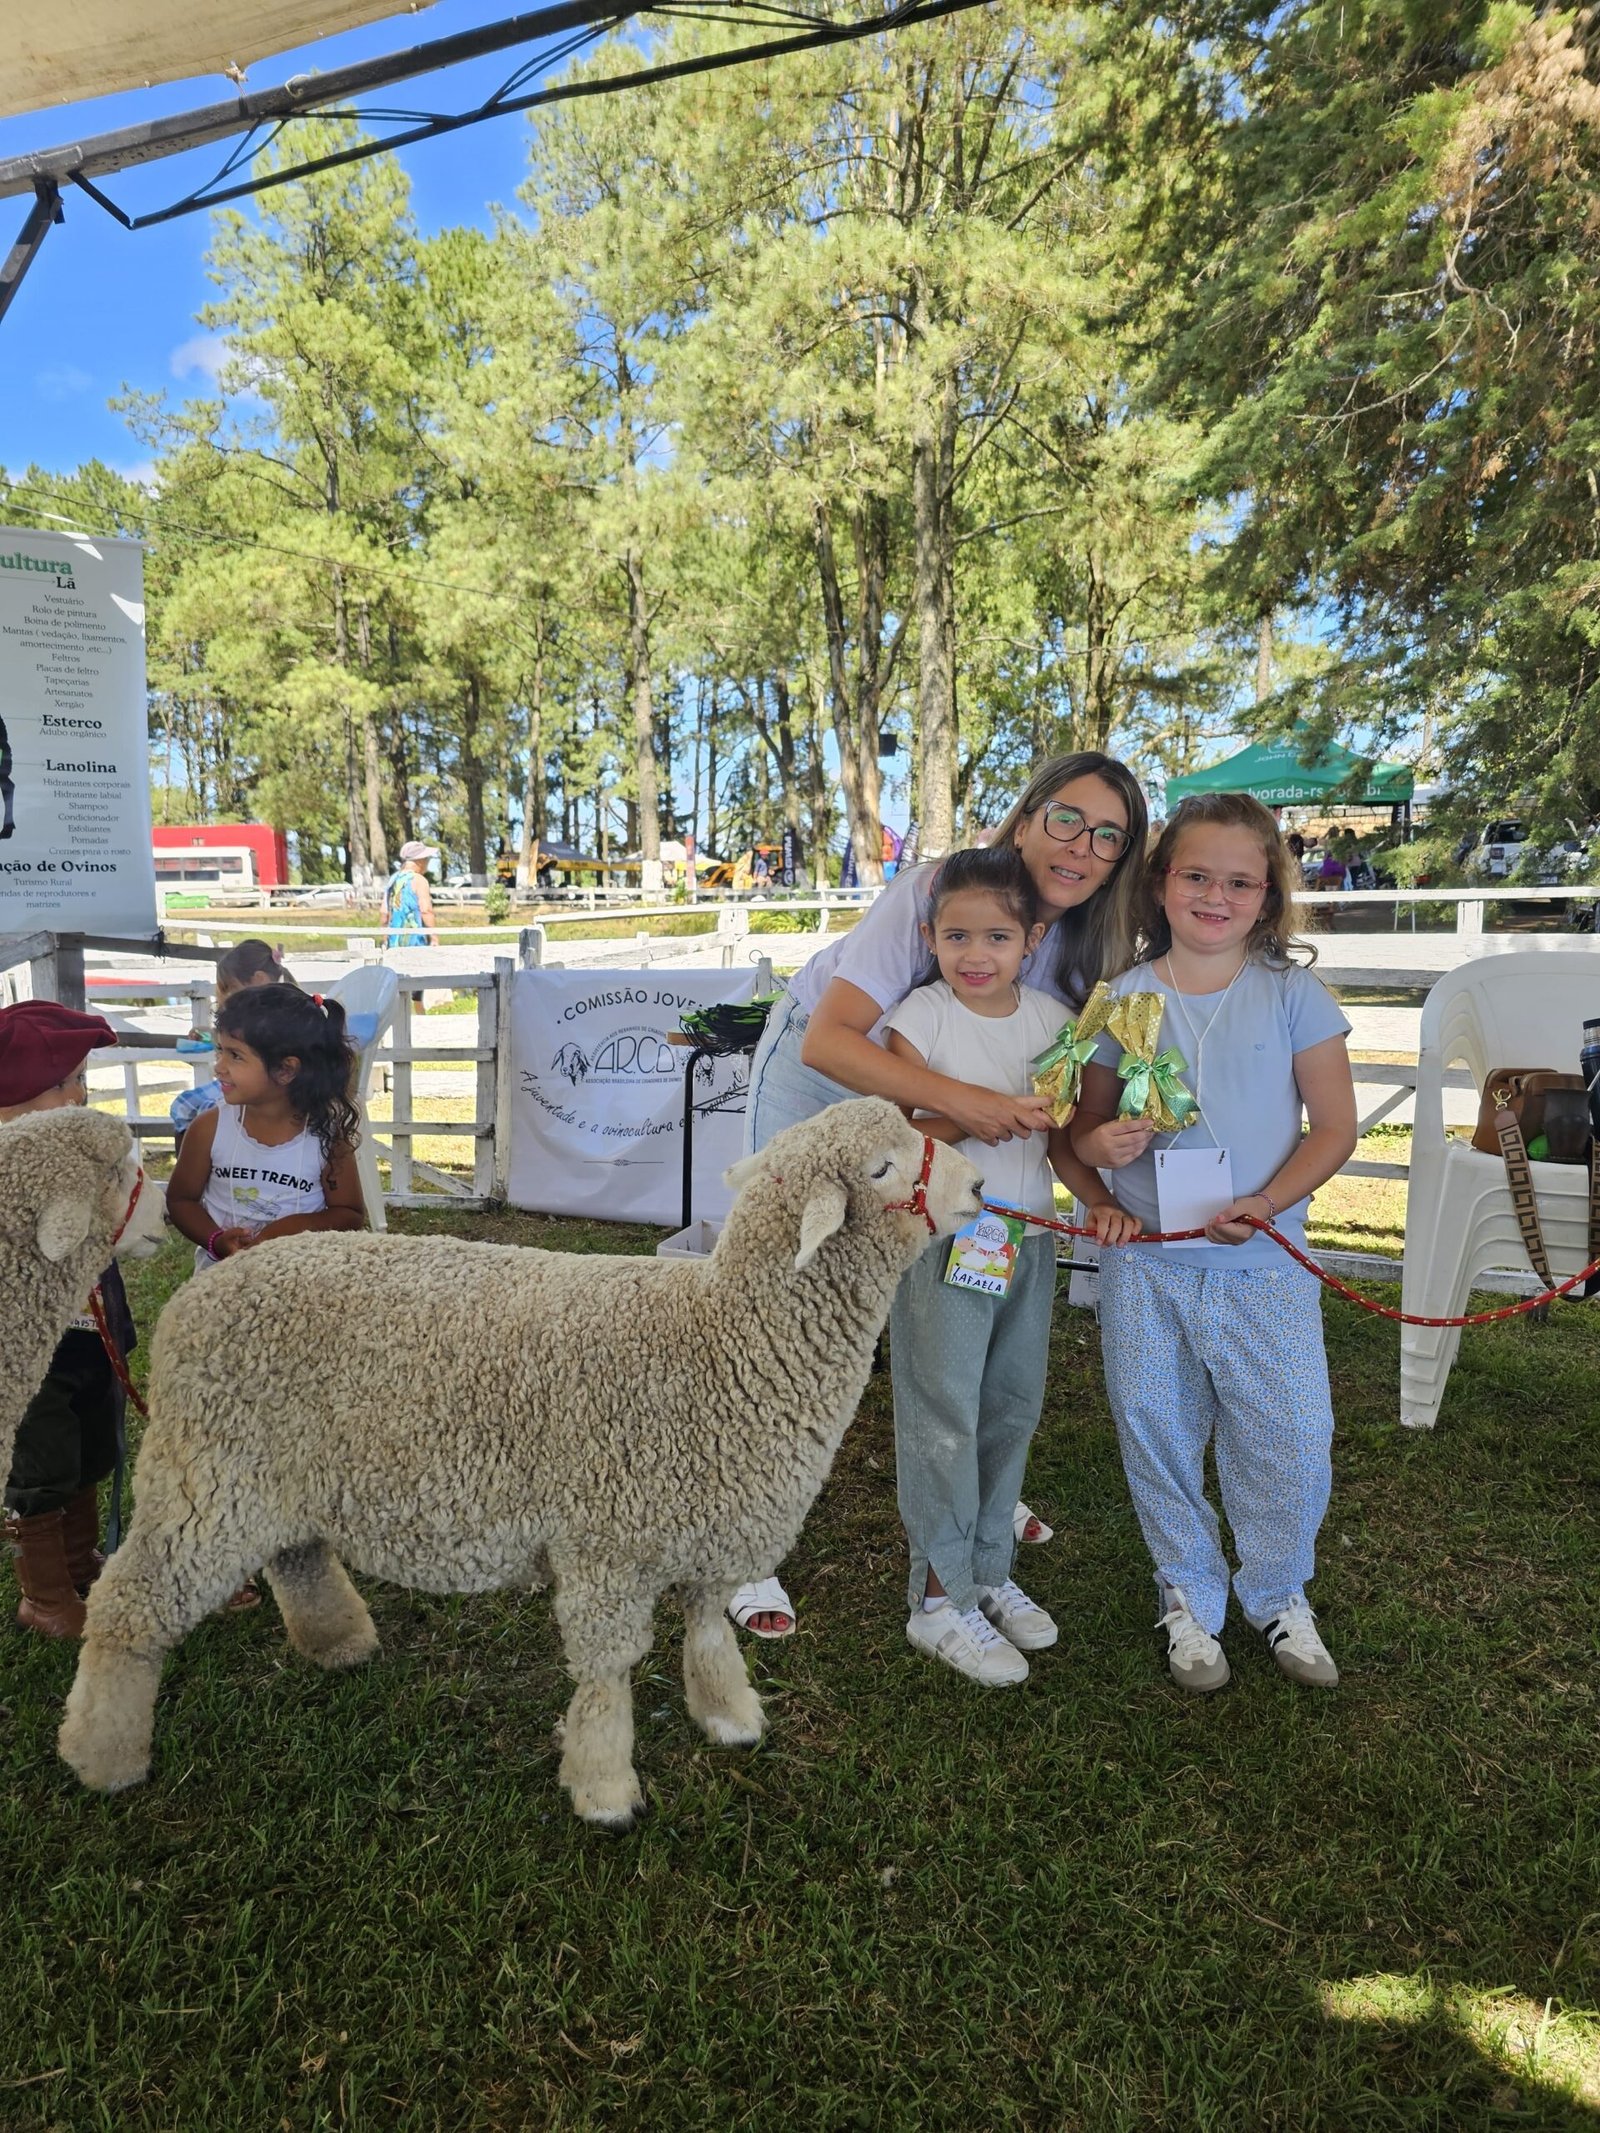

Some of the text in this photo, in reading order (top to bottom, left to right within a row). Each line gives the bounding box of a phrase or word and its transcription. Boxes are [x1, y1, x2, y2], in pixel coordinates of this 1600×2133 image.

[0, 552, 73, 575] ultura
[56, 576, 76, 590] Lã
[44, 594, 85, 606] Vestuário
[32, 604, 97, 619] Rolo de pintura
[24, 616, 106, 631] Boina de polimento
[2, 626, 33, 636] Mantas
[41, 629, 79, 641] vedação,
[81, 632, 127, 644] lixamentos,
[20, 640, 85, 651] amortecimento
[52, 653, 81, 663] Feltros
[36, 663, 100, 676] Placas de feltro
[44, 676, 90, 687] Tapeçarias
[44, 687, 94, 698] Artesanatos
[54, 699, 85, 709] Xergão
[42, 714, 103, 729] Esterco
[39, 727, 107, 739] Adubo orgânico
[1254, 752, 1286, 764] JOHN
[46, 759, 117, 774] Lanolina
[43, 778, 131, 790] Hidratantes corporais
[53, 790, 122, 800] Hidratante labial
[68, 802, 109, 812] Shampoo
[58, 812, 120, 823] Condicionador
[68, 824, 112, 834] Esfoliantes
[71, 836, 109, 845] Pomadas
[48, 847, 81, 856] Cremes
[82, 848, 101, 857] para
[111, 848, 132, 856] rosto
[37, 861, 57, 873] de
[61, 860, 117, 873] Ovinos
[14, 878, 73, 887] Turismo Rural
[23, 890, 34, 898] de
[35, 890, 90, 899] reprodutores
[26, 901, 61, 909] matrizes
[564, 987, 703, 1021] COMISSÃO JOVE
[520, 1070, 538, 1082] A
[521, 1086, 577, 1124] juventude
[578, 1121, 586, 1129] e
[591, 1124, 599, 1134] a
[602, 1117, 674, 1138] ovinocultura
[215, 1167, 314, 1193] SWEET TRENDS
[951, 1266, 1002, 1292] RAFAELA
